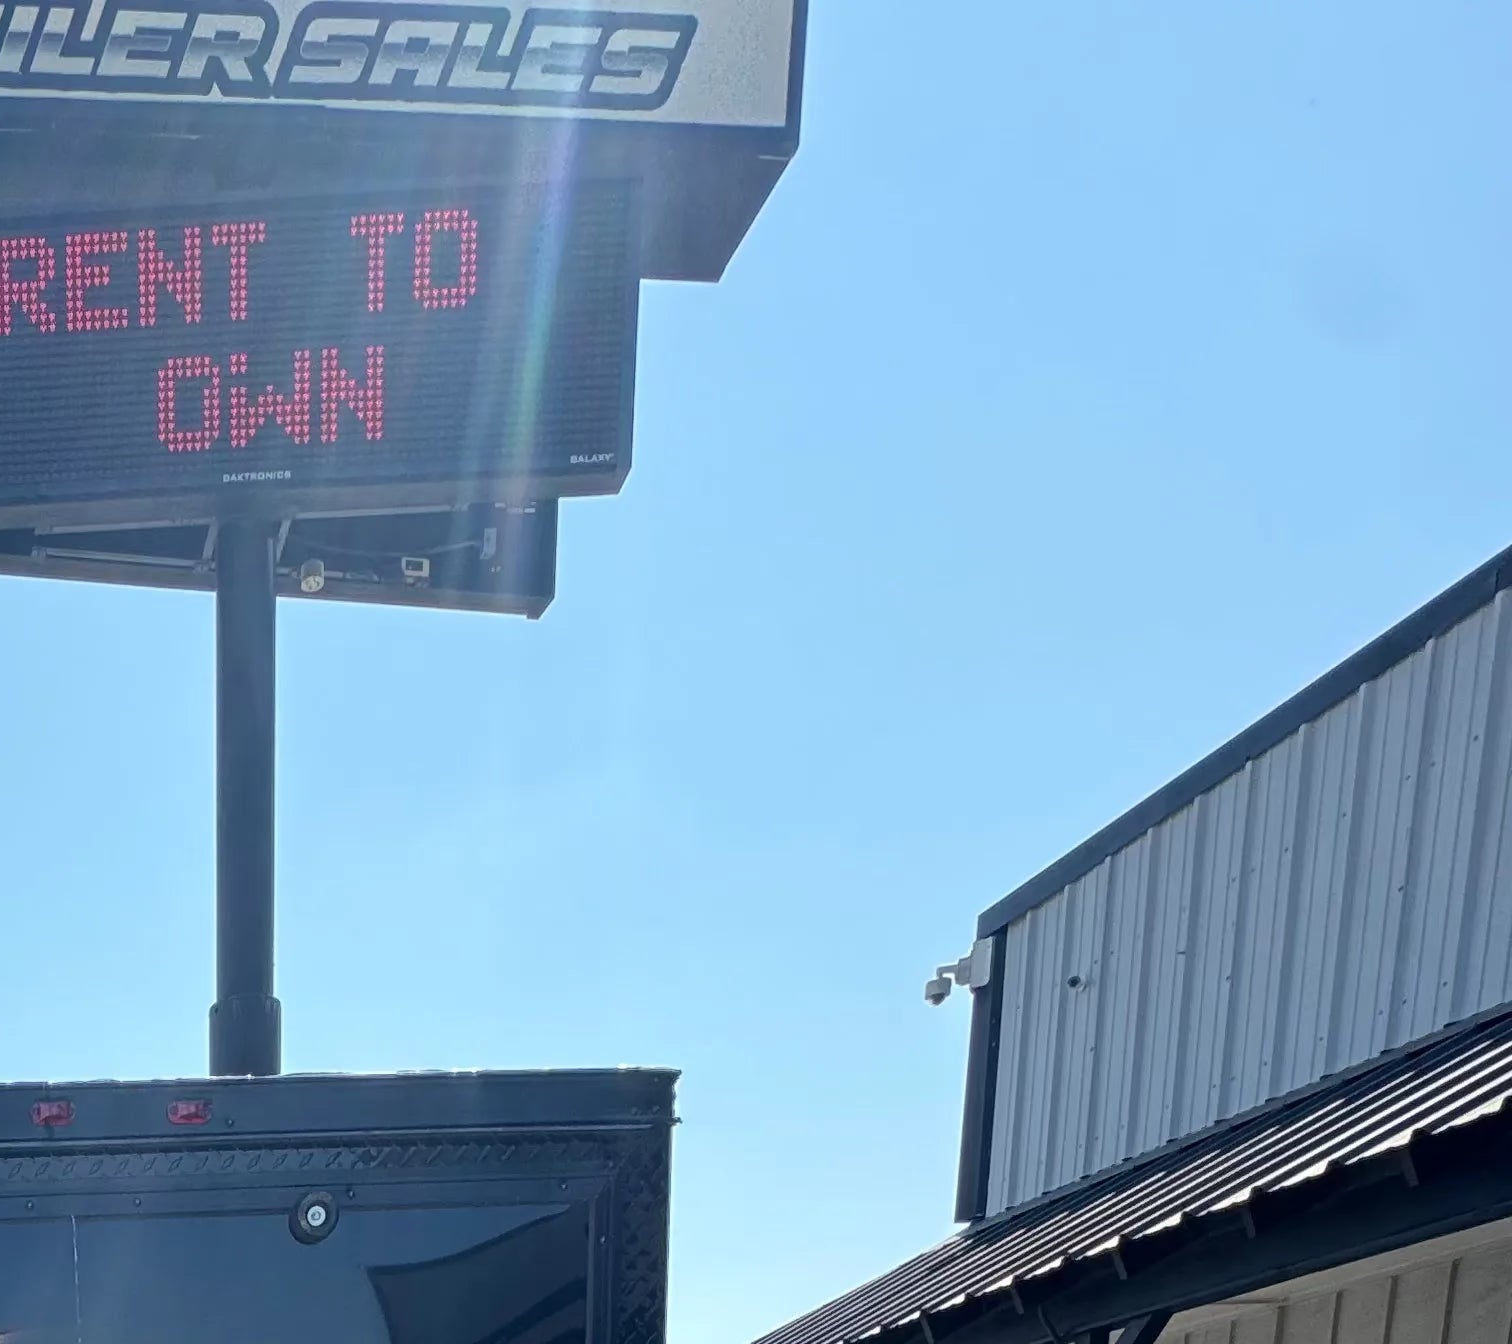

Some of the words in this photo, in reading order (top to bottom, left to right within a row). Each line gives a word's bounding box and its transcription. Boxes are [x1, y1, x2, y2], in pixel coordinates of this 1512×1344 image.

[287, 16, 682, 96] SALES
[350, 209, 478, 312] TO
[222, 470, 292, 483] DAKTRONICS
